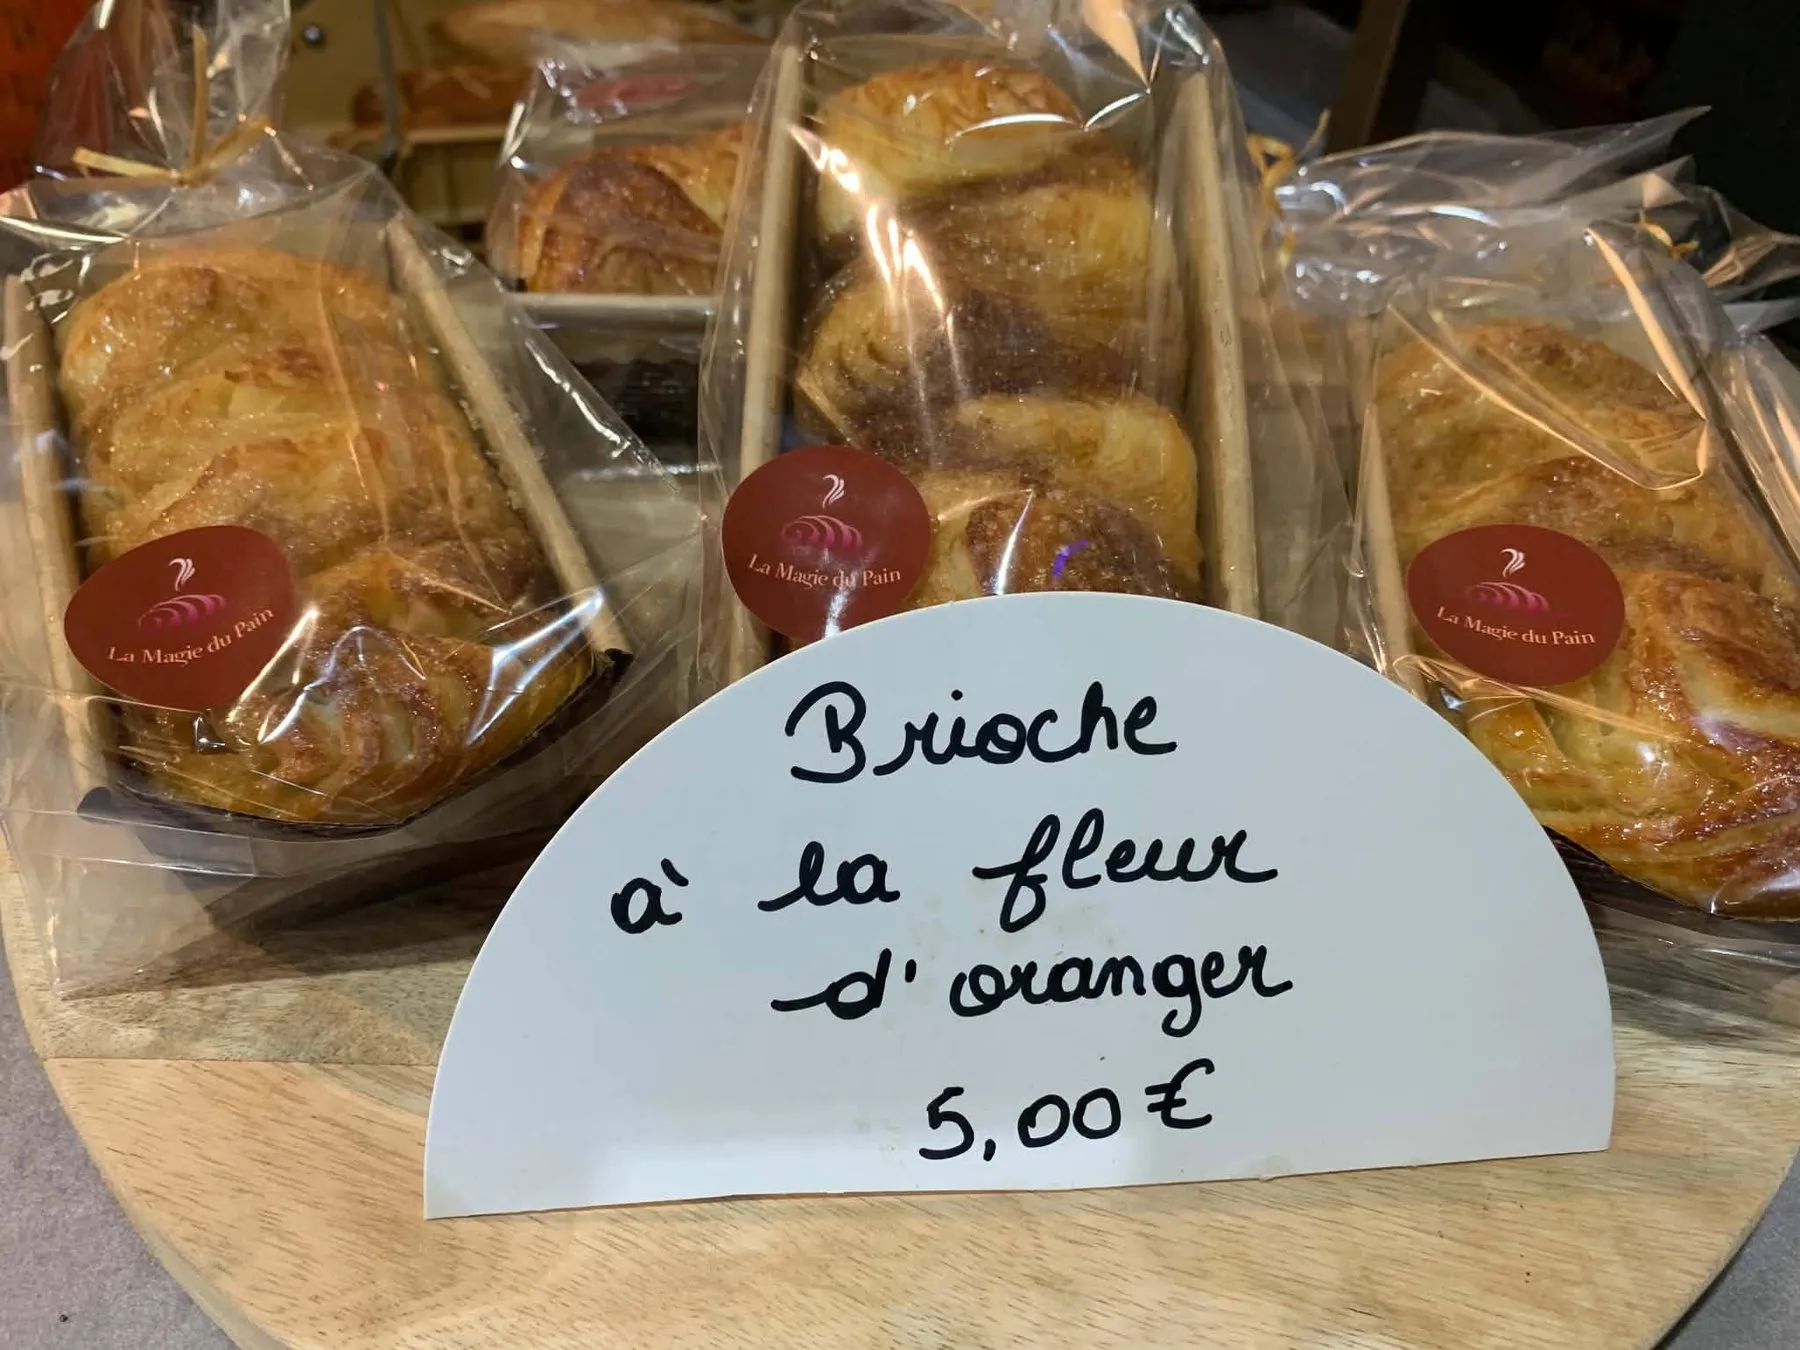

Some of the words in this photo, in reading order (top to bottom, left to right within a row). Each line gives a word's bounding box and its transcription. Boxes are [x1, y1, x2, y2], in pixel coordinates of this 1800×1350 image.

[747, 553, 771, 576] La
[775, 562, 828, 589] Magie
[832, 570, 856, 587] du
[862, 567, 901, 586] Pain
[107, 646, 134, 663] La
[142, 646, 204, 668] Magie
[206, 633, 232, 653] du
[234, 608, 275, 639] Pain
[1436, 605, 1459, 625] La
[1464, 615, 1519, 641] Magie
[1522, 629, 1548, 645] du
[1551, 630, 1596, 646] Pain
[785, 681, 1178, 783] Brioche
[611, 857, 689, 934] à
[758, 840, 901, 912] la
[972, 807, 1279, 934] fleur
